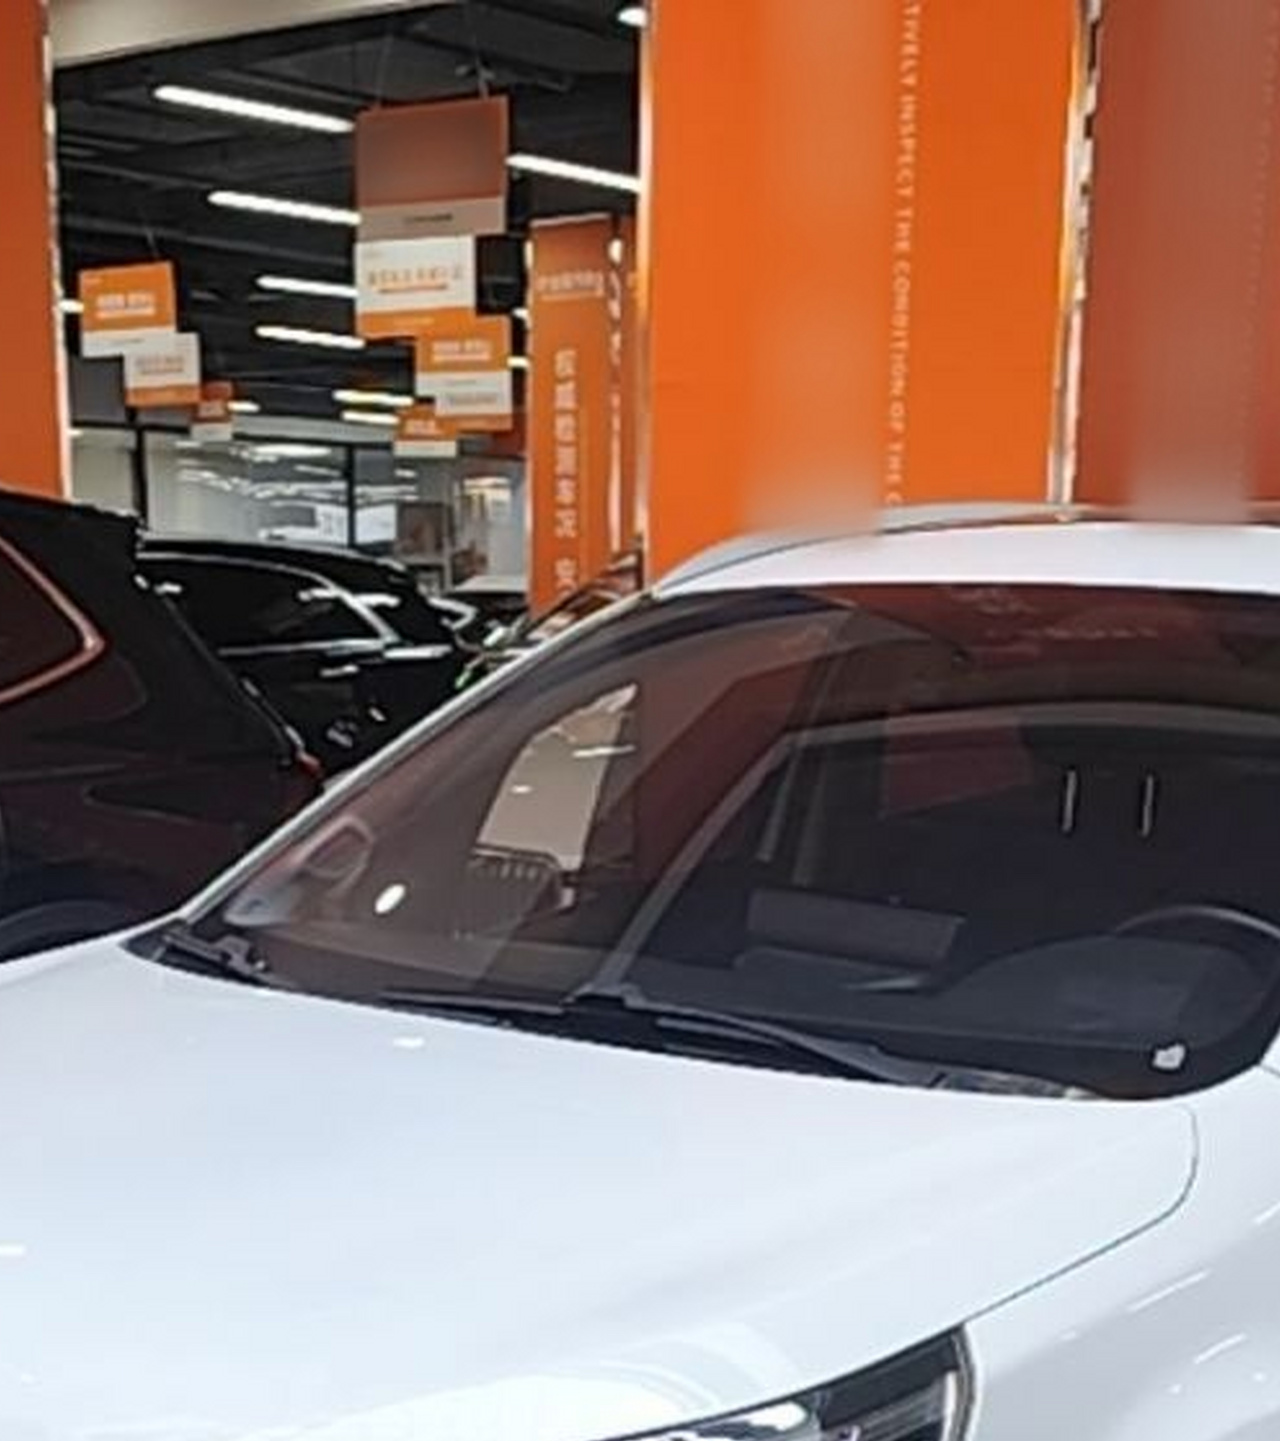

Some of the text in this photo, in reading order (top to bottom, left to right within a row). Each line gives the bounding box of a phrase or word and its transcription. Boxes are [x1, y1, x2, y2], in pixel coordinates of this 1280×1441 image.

[895, 95, 919, 198] INSPECT
[892, 207, 915, 254] THE
[887, 260, 912, 396] CONDITION
[889, 400, 908, 434] OF
[885, 442, 906, 484] THE
